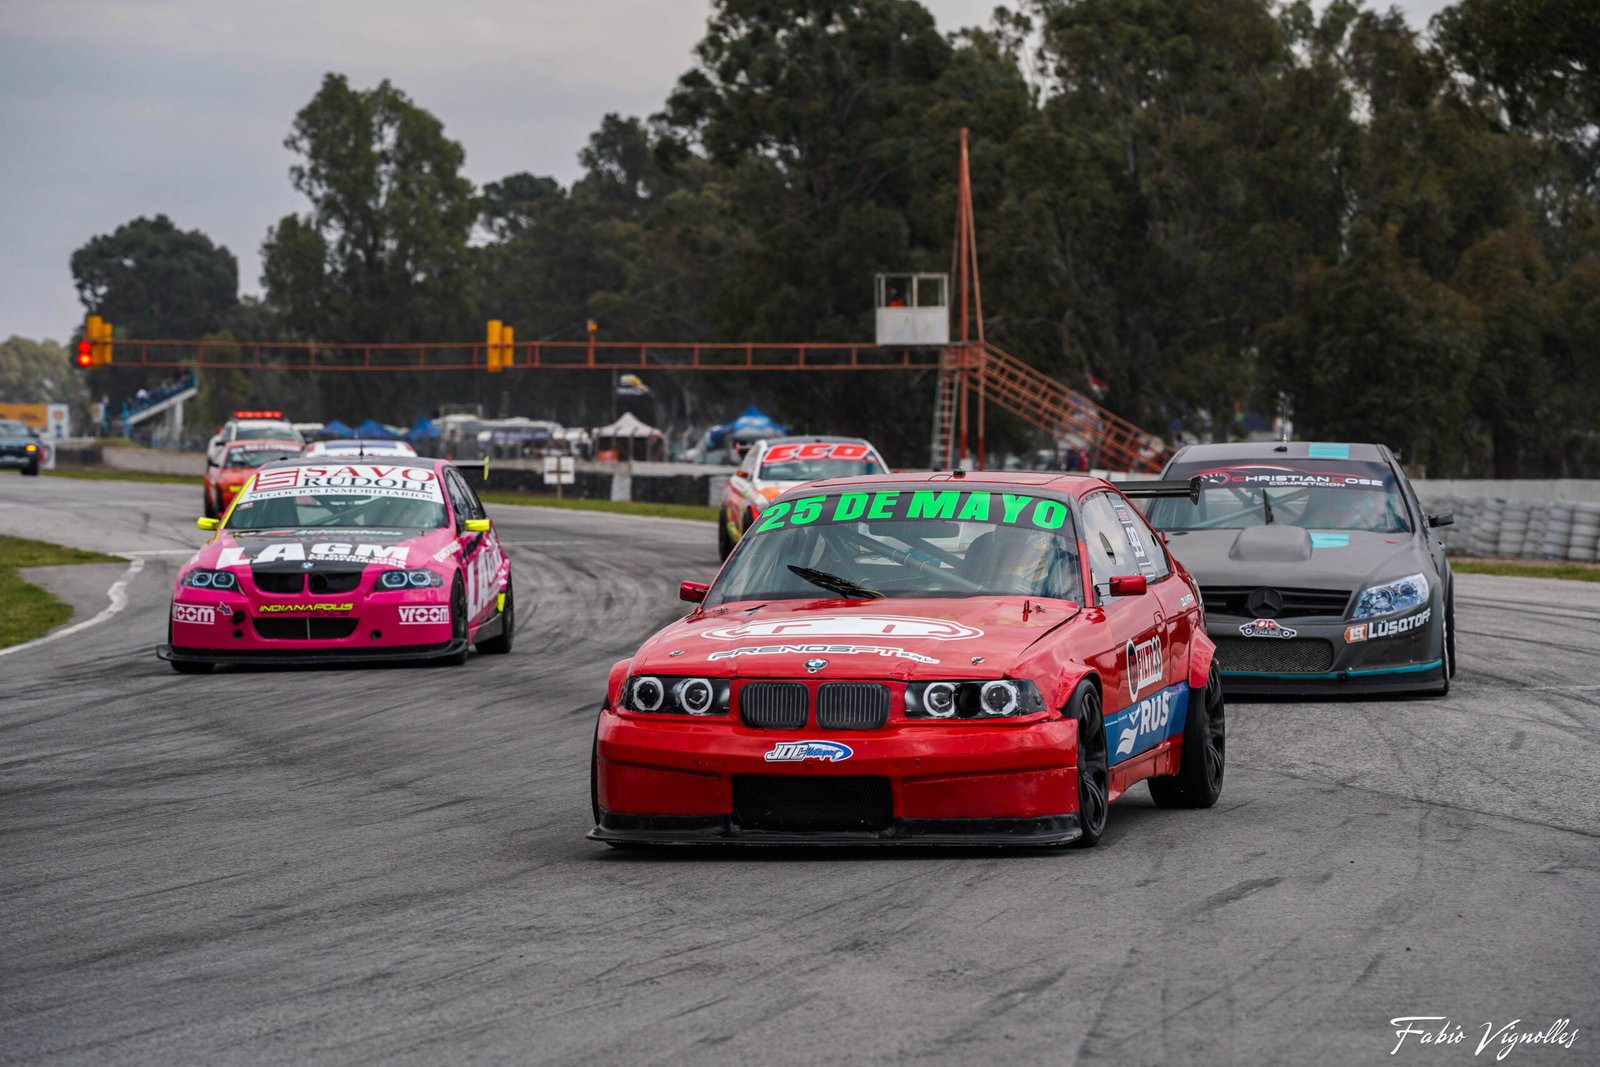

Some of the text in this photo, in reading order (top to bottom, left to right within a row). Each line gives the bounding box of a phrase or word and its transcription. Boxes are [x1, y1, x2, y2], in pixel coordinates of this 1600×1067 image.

[764, 443, 869, 462] ECO
[304, 466, 435, 482] SAVO
[303, 477, 433, 491] RUDOLF
[250, 487, 434, 500] NEGOCIOS INMOBILIARIOS
[756, 490, 1068, 533] 25 DE MAYO
[216, 543, 410, 569] LAGM
[258, 603, 353, 614] INDIANAPOLIS
[399, 608, 449, 622] vroom
[1139, 691, 1171, 735] RUS
